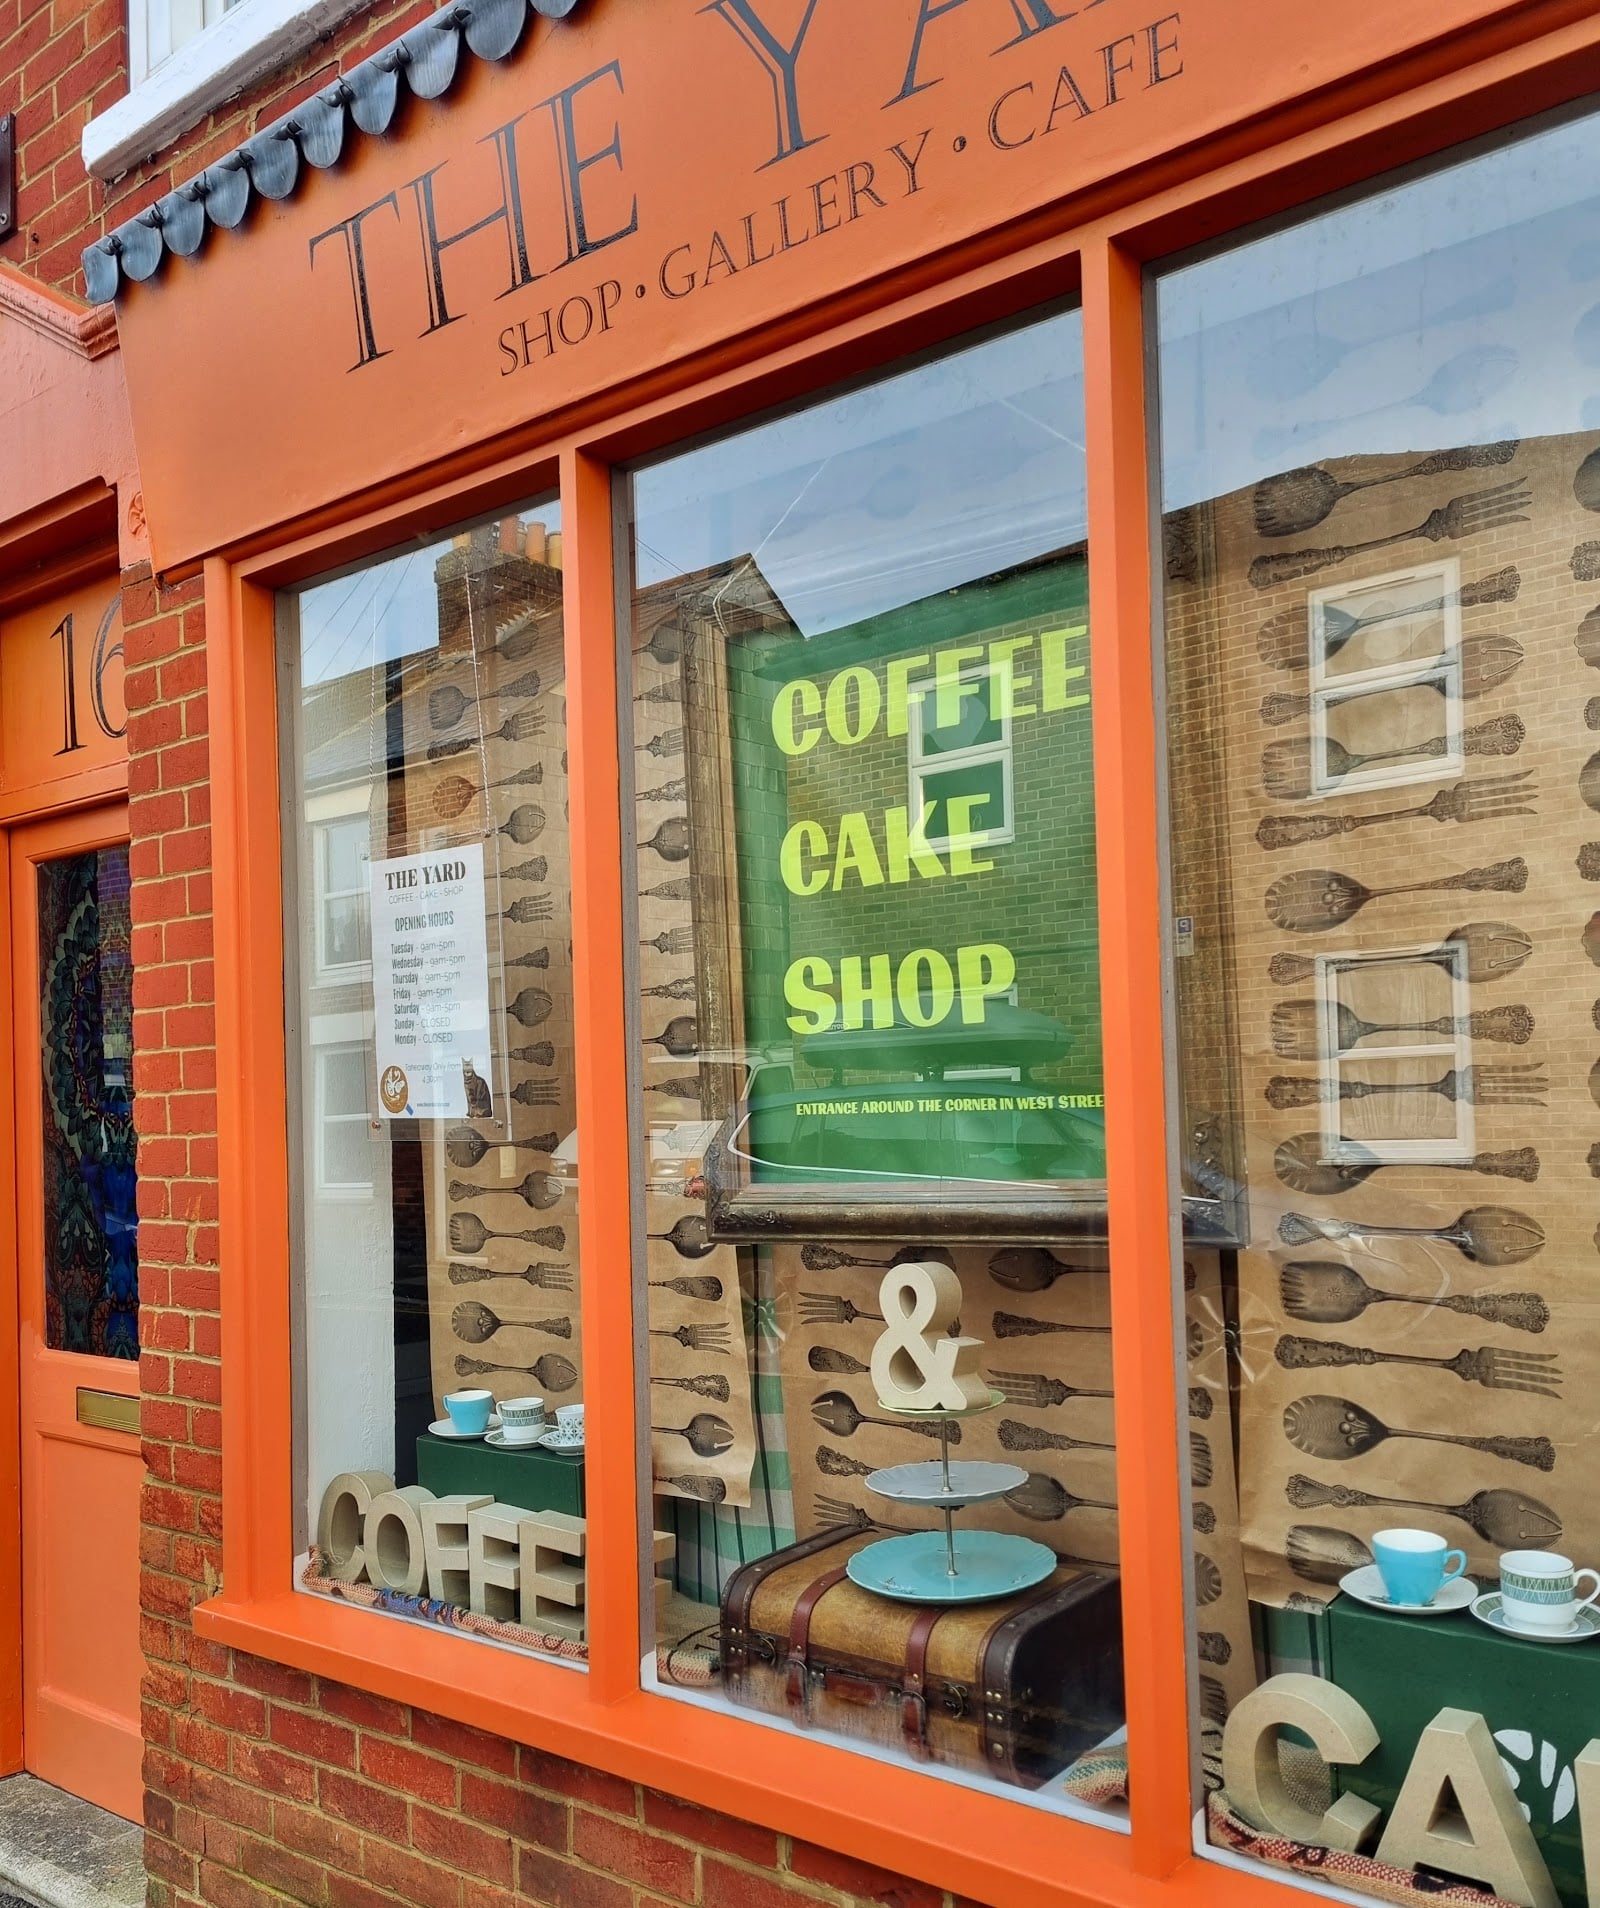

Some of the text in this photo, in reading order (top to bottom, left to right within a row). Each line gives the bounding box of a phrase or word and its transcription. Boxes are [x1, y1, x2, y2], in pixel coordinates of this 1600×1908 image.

[498, 12, 1185, 377] SHOP GALLERY CAFE
[309, 58, 639, 374] THE
[50, 592, 128, 757] 16
[771, 625, 1091, 755] COFFEE
[780, 793, 994, 896] CAKE
[385, 860, 466, 891] THE YARD
[388, 884, 464, 905] COFFEE CAKE SHOP
[395, 910, 454, 932] OPENING HOURS
[391, 941, 414, 955] Tuesday
[391, 955, 424, 969] Wednesday
[392, 972, 418, 985] Thursday
[783, 943, 1016, 1035] SHOP
[393, 987, 411, 1001] Friday
[394, 1002, 419, 1016] Saturday
[394, 1017, 451, 1031] Sunday CLOSED
[394, 1032, 453, 1046] Monday CLOSED
[796, 1094, 1105, 1116] ENTRANCE AROUND THE CORNER IN WEST STREE
[870, 1261, 991, 1411] &
[319, 1471, 585, 1641] COFFEE
[1222, 1672, 1600, 1908] CA
